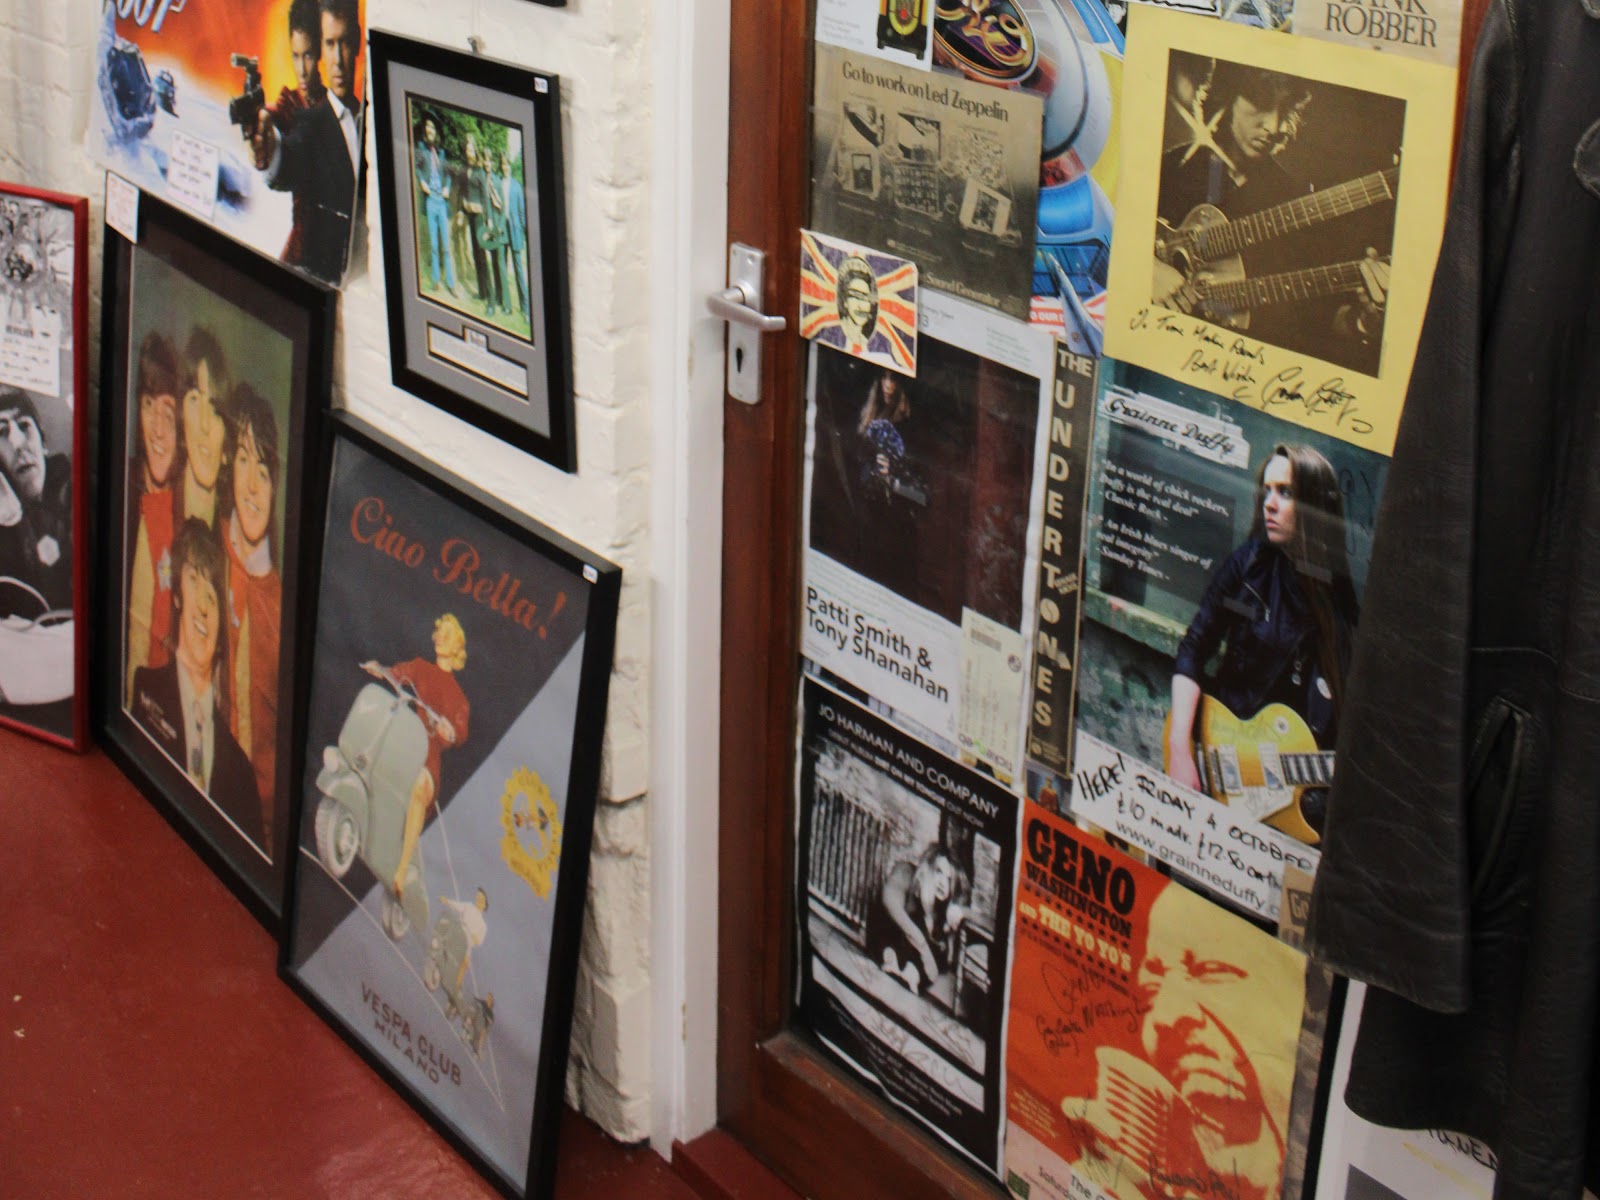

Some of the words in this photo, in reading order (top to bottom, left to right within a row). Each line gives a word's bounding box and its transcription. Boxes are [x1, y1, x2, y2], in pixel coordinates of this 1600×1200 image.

[1325, 2, 1438, 48] ROBBER
[842, 60, 860, 81] Go
[861, 69, 874, 85] to
[876, 74, 906, 95] work
[907, 84, 924, 97] on
[925, 84, 949, 106] Led
[951, 88, 1010, 123] Zeppelin
[1057, 348, 1094, 378] THE
[1181, 422, 1236, 460] Duffy
[351, 496, 426, 568] Ciao
[432, 537, 568, 641] Bella!
[806, 586, 850, 628] Patti
[854, 613, 914, 662] Smith
[916, 646, 933, 673] &
[806, 605, 848, 651] Tony
[852, 634, 950, 704] Shanahan
[818, 702, 835, 722] JO
[836, 713, 895, 756] HARMAN
[896, 748, 925, 775] AND
[926, 766, 1000, 820] COMPANY
[1077, 752, 1126, 802] HERE!
[1024, 860, 1132, 940] WASHINGTON
[1025, 816, 1138, 917] GENO
[1038, 903, 1072, 940] THE
[1073, 924, 1096, 951] YO
[360, 980, 413, 1043] VESPA
[417, 1033, 463, 1088] CLUB
[373, 1017, 441, 1087] MILANO
